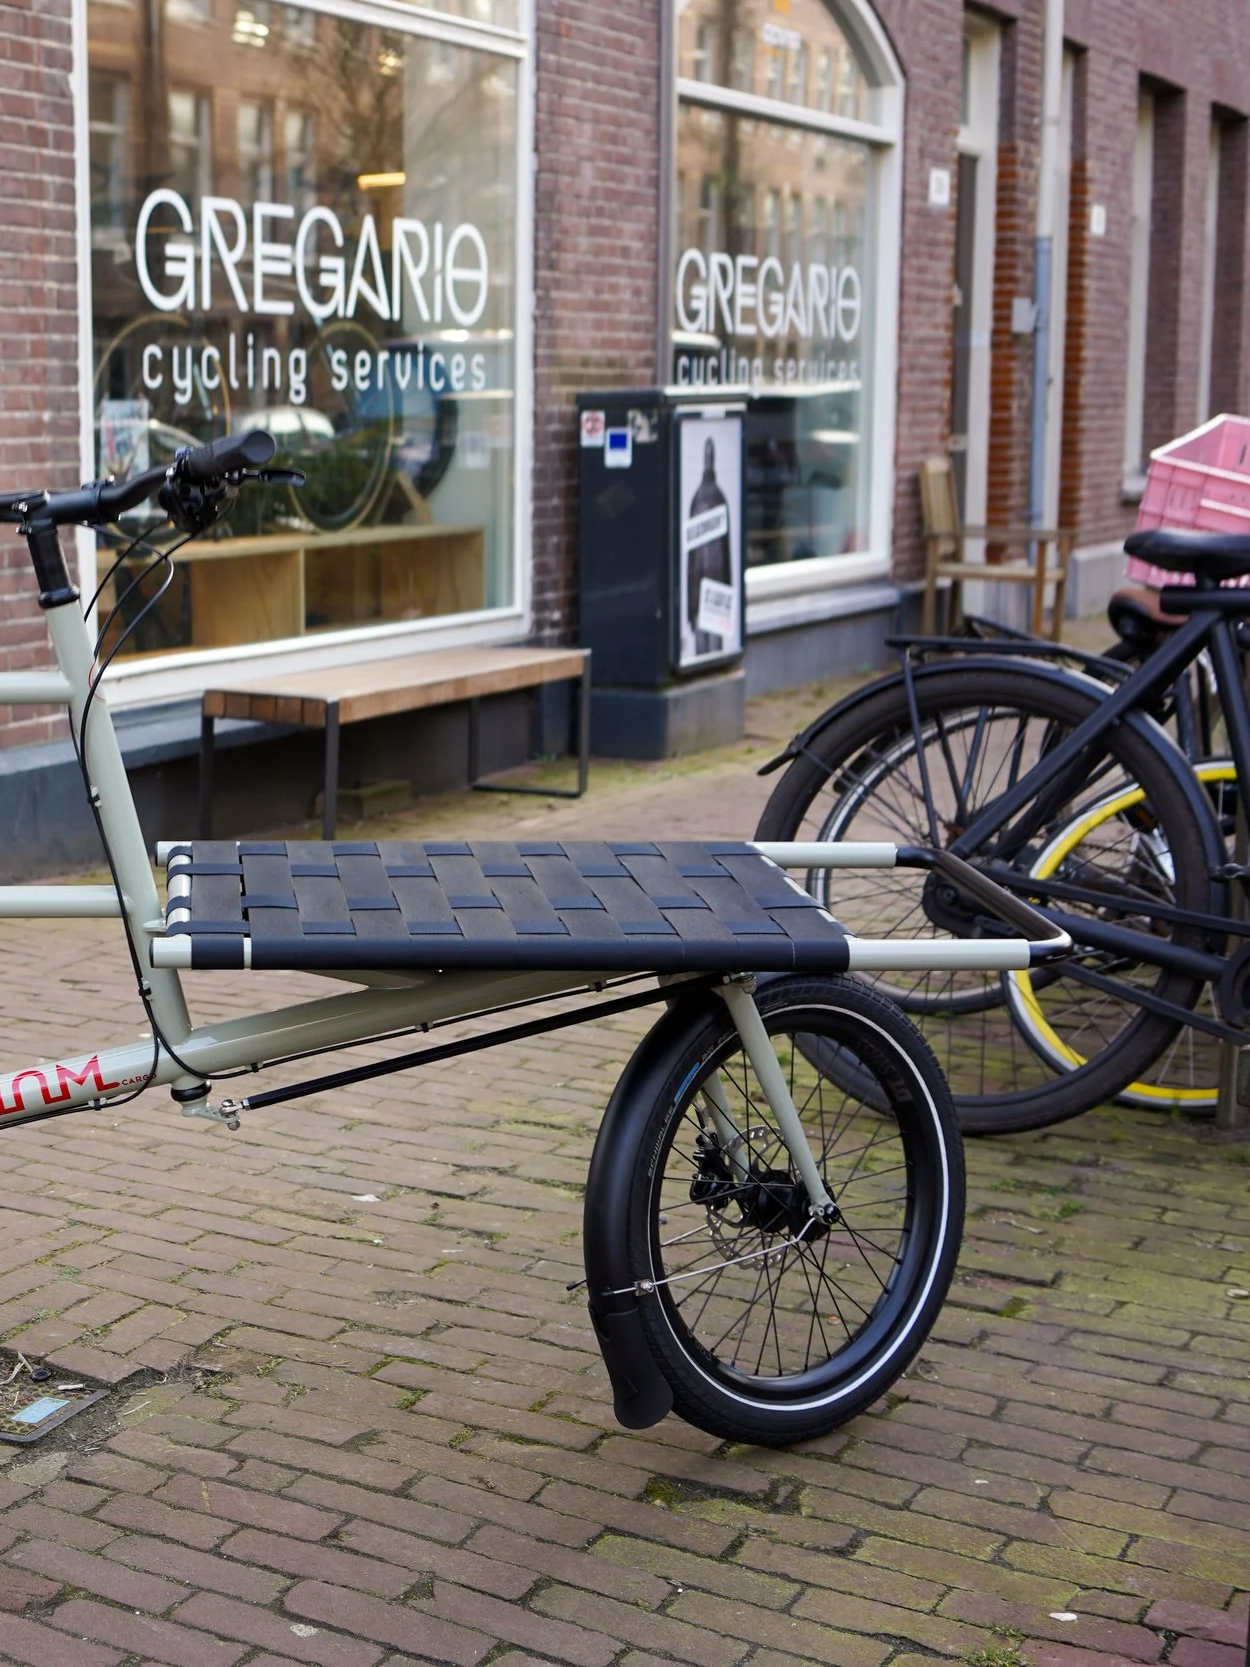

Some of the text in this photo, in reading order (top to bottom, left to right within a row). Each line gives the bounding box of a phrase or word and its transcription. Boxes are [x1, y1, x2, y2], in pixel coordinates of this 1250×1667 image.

[136, 188, 489, 327] GREGARIO
[676, 248, 862, 342] GREGARIO
[143, 332, 487, 405] cycling services
[773, 352, 859, 387] services
